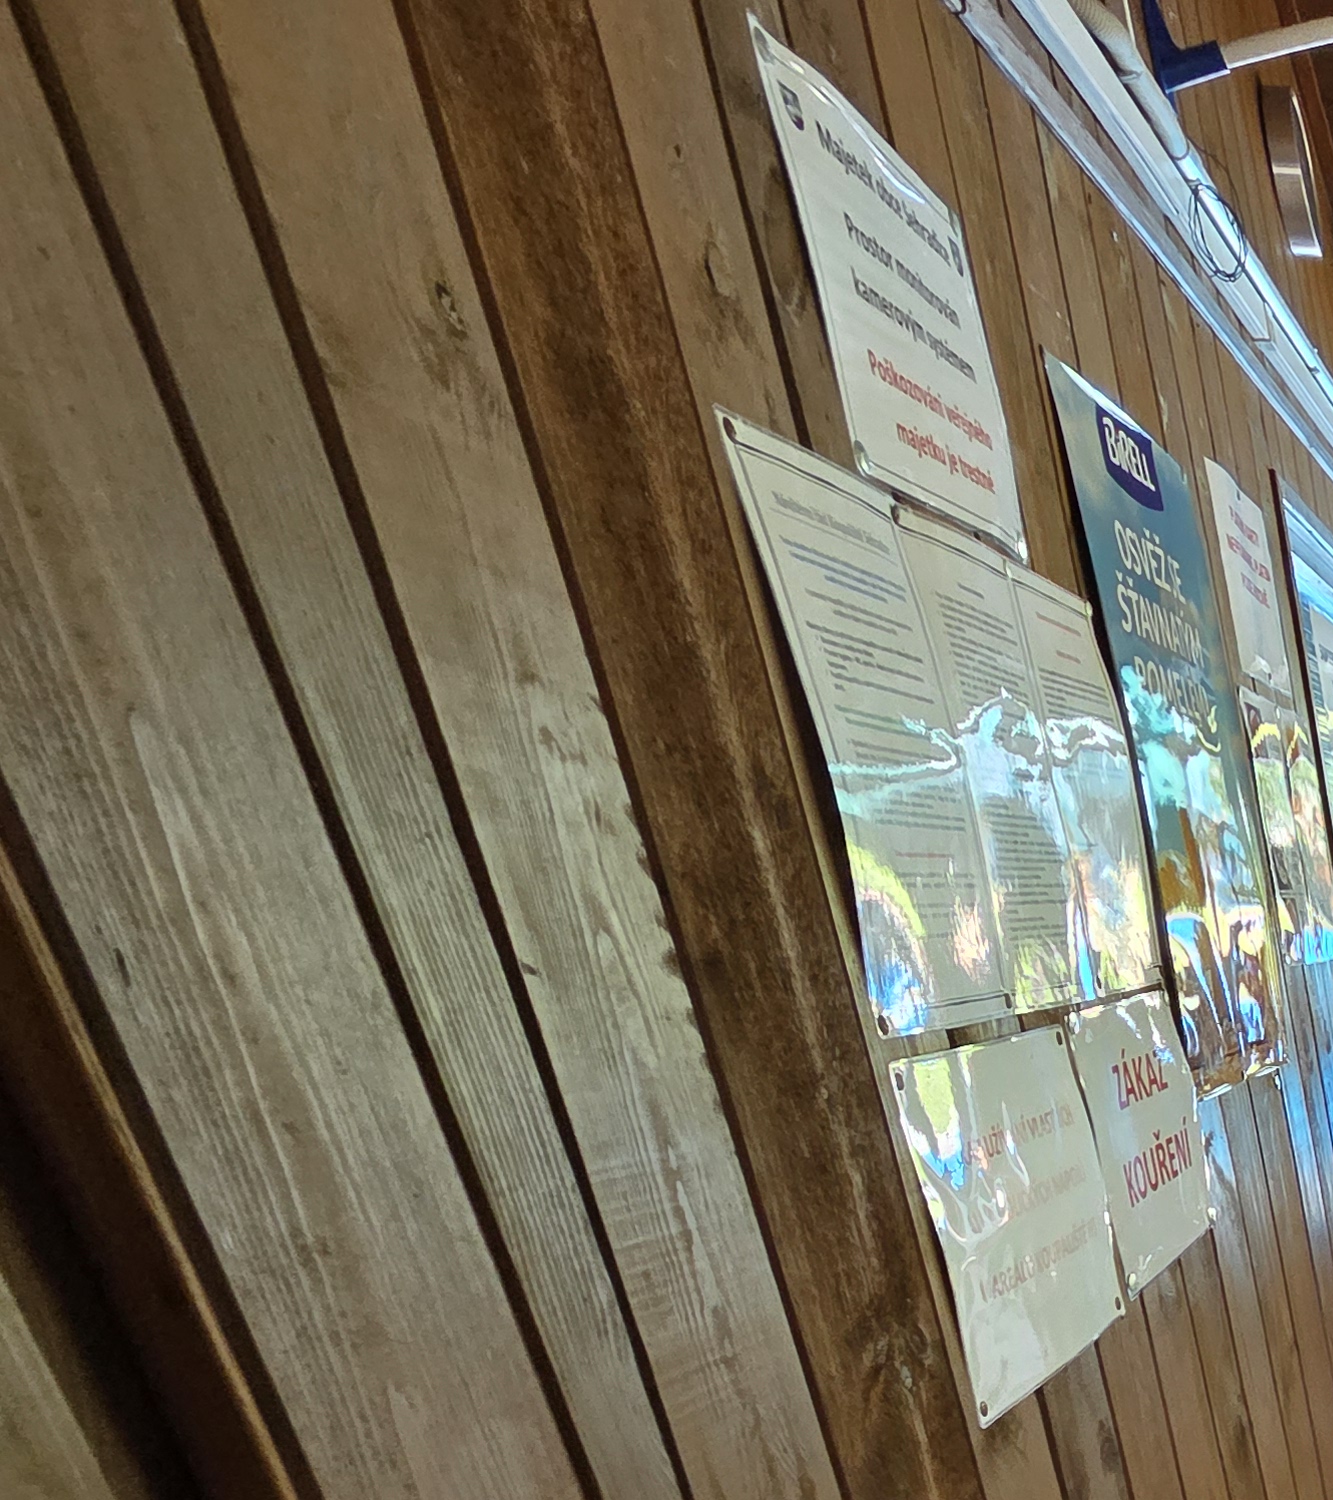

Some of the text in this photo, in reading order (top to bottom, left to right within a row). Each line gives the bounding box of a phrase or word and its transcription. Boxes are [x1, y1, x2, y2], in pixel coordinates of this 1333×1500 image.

[844, 211, 894, 272] Prostor
[896, 422, 948, 466] majetku
[1111, 1048, 1169, 1111] ZÁKAZ
[1123, 1115, 1193, 1208] KOUŘENÍ
